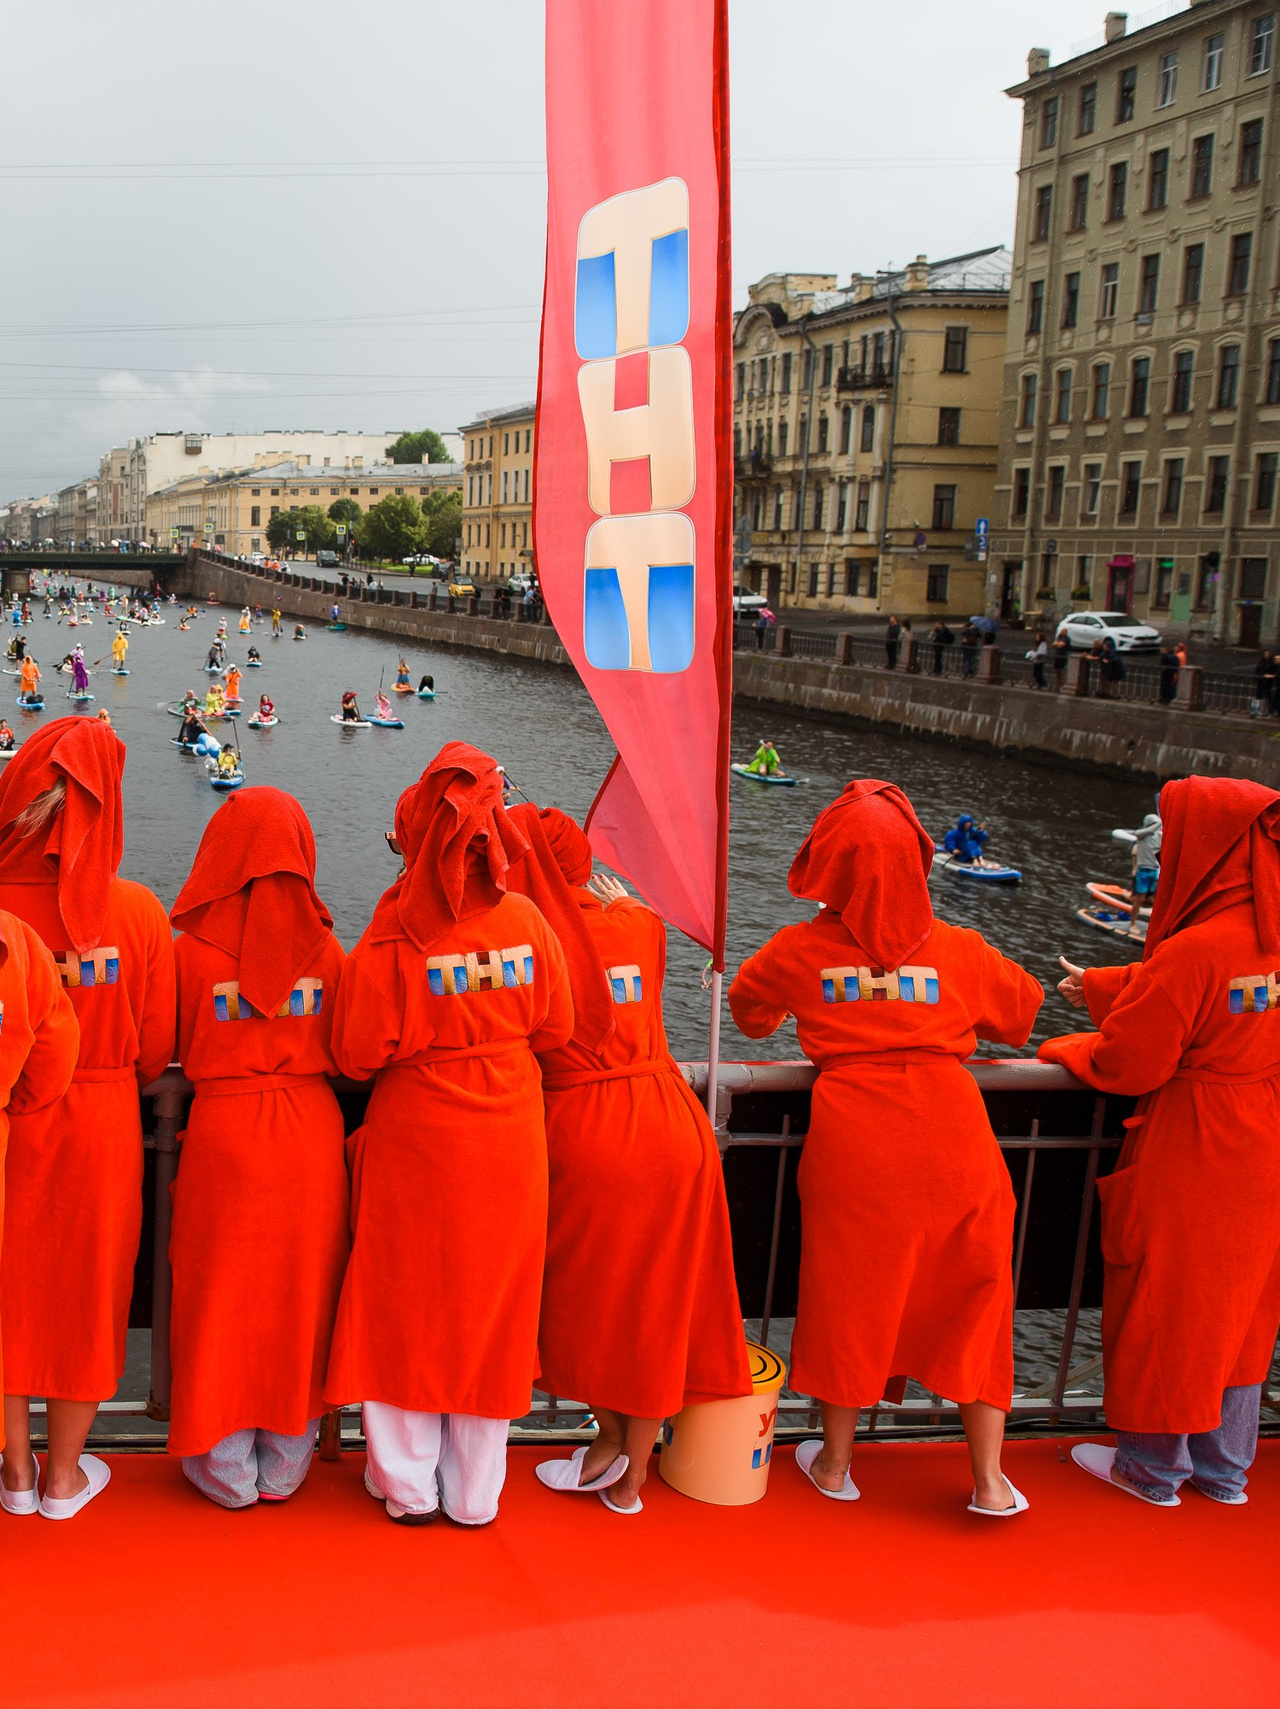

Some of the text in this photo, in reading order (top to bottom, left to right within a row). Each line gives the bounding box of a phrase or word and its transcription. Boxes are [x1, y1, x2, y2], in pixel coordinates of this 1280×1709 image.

[573, 176, 697, 674] ТНТ
[51, 946, 120, 988] НТ
[426, 944, 534, 996] ТНТ
[820, 965, 940, 1005] ТНТ
[212, 976, 323, 1022] ТТ
